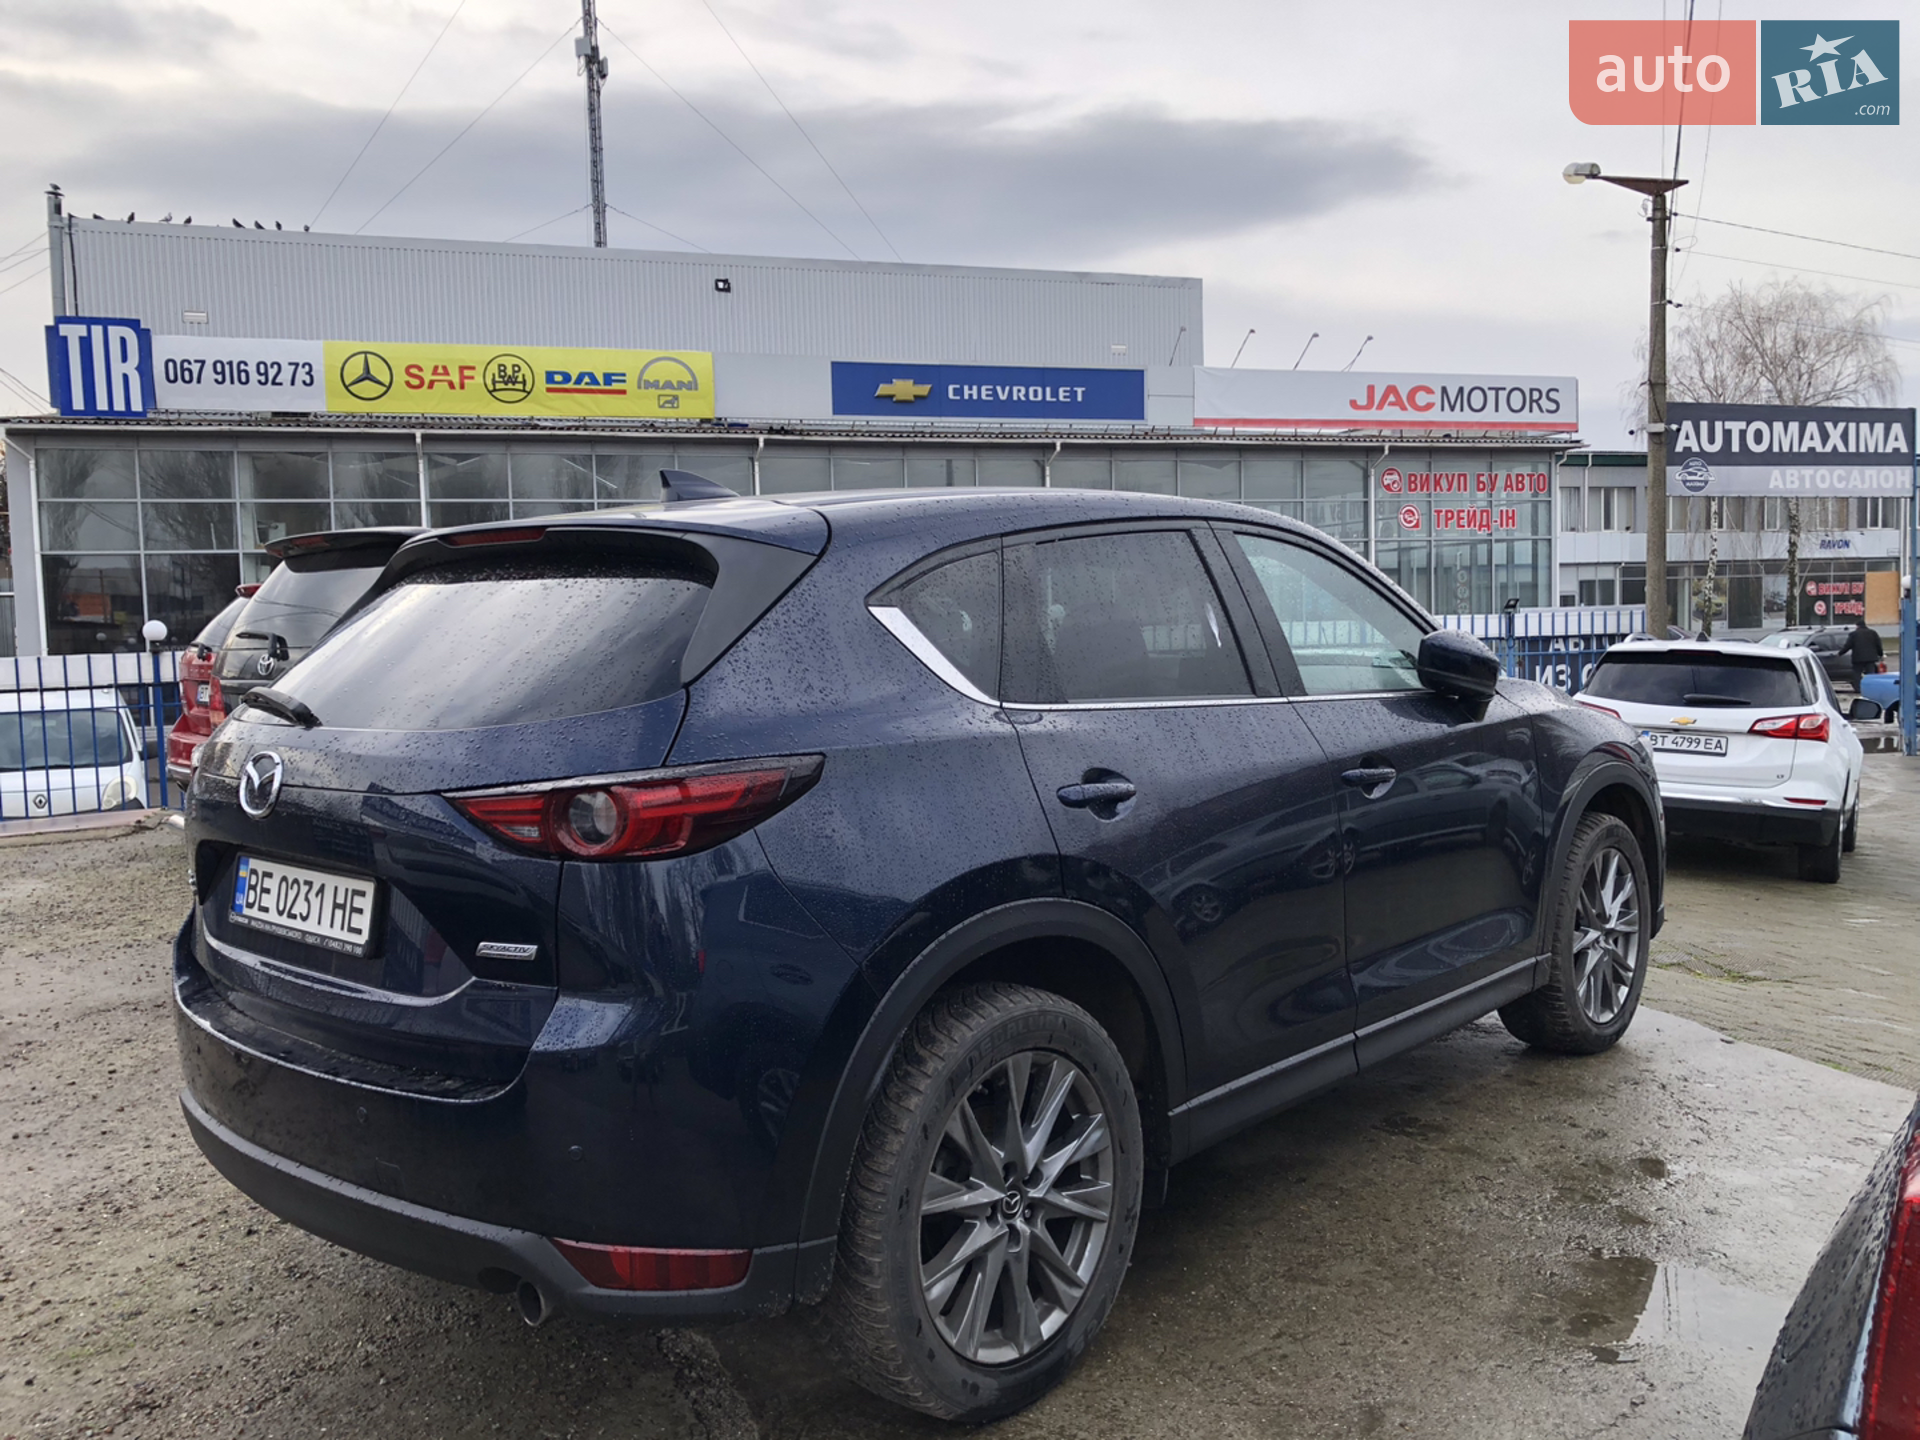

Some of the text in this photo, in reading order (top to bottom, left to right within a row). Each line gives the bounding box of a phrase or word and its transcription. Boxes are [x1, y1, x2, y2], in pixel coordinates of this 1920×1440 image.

[58, 324, 144, 412] TIR
[164, 358, 315, 387] 067 916 92 73
[404, 364, 476, 390] SAF
[545, 370, 627, 386] DAF
[643, 380, 693, 391] MAN
[948, 384, 1086, 402] CHEVROLET
[1674, 420, 1909, 453] AUTOMAXIMA
[1407, 473, 1548, 493] ВИКУП БУ АВТО
[1768, 468, 1910, 489] АВТОСАЛОН
[1820, 539, 1850, 549] RAVON
[1672, 736, 1701, 748] 4799
[1704, 739, 1723, 750] EA
[245, 868, 273, 913] BE
[276, 875, 325, 925] 0231
[330, 886, 366, 934] HE
